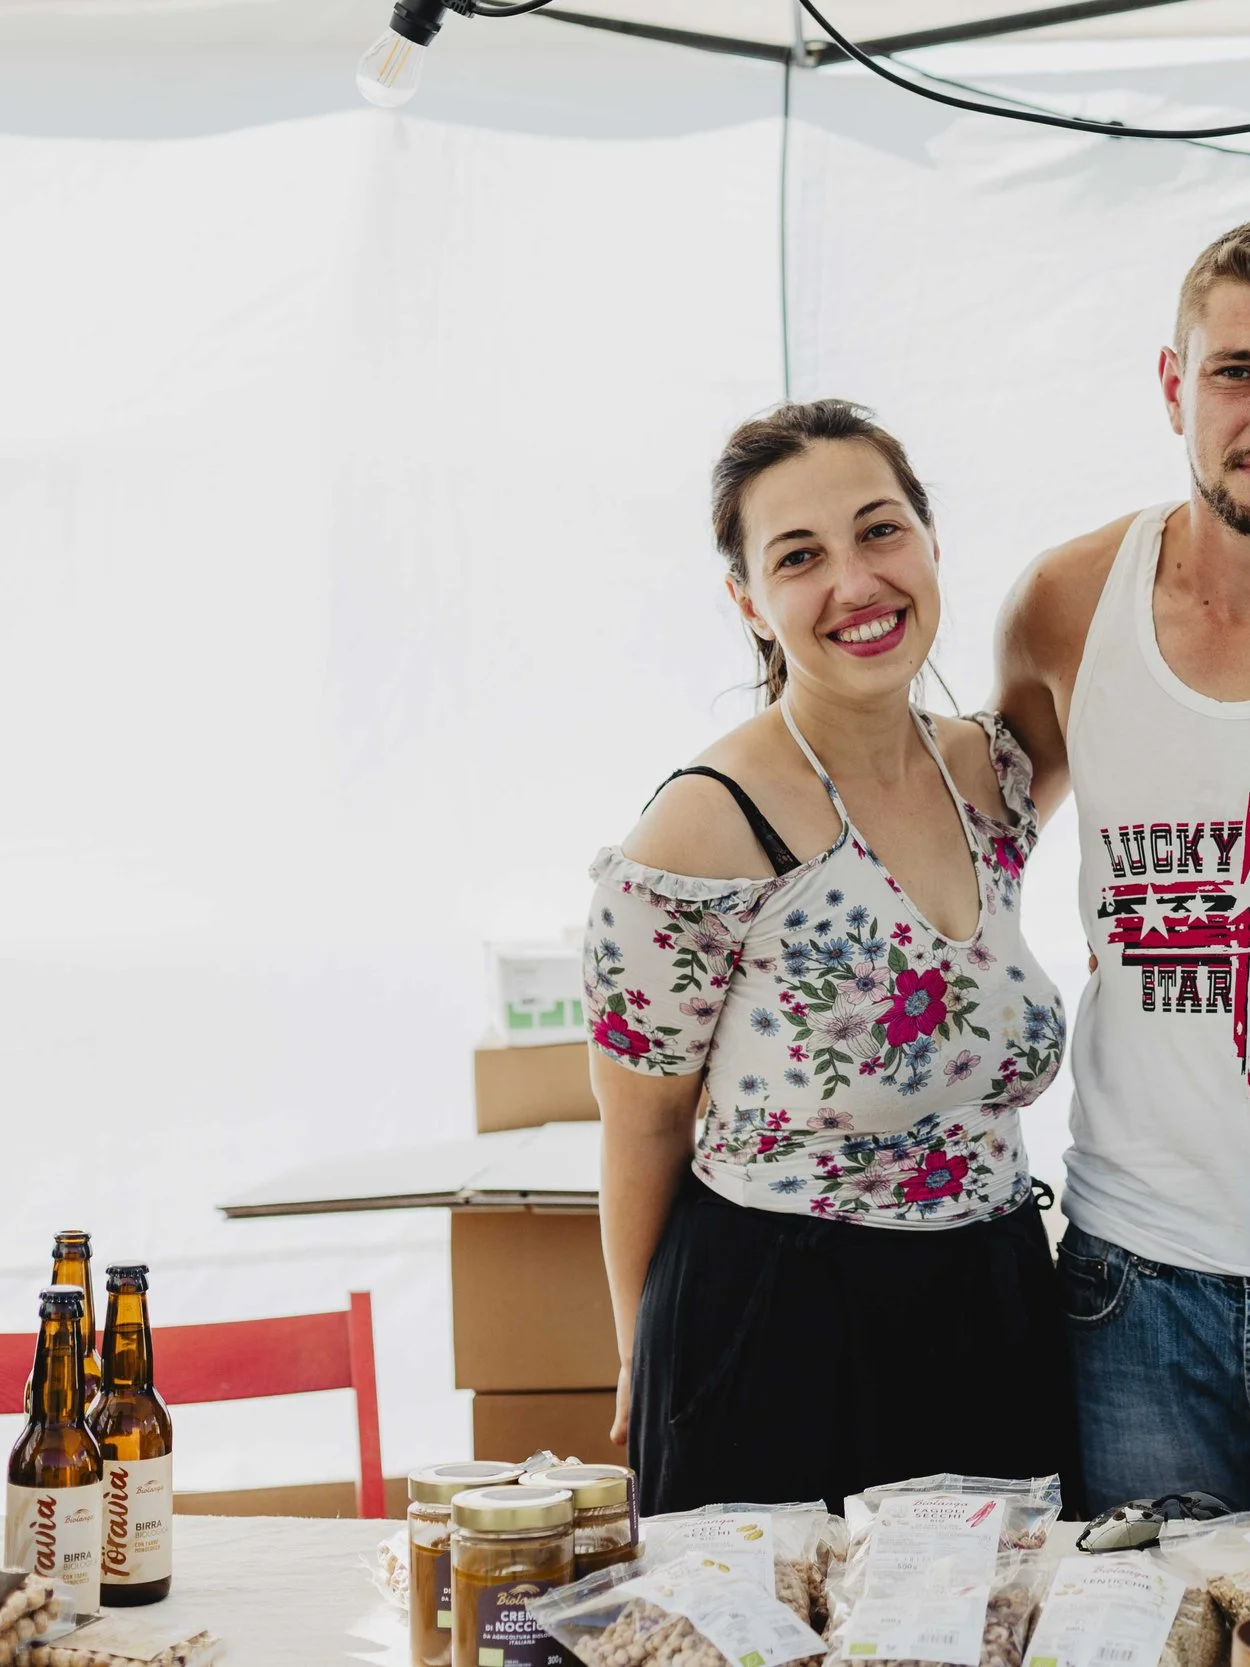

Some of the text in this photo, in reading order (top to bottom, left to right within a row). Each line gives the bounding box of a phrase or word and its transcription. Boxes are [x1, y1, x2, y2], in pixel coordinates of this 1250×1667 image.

[1100, 820, 1243, 878] LUCKY
[1141, 963, 1233, 1013] STAR
[136, 1484, 164, 1495] Biolanga
[135, 1520, 162, 1532] BIRRA
[63, 1552, 92, 1563] BIRRA
[501, 1610, 539, 1622] CREM
[485, 1624, 493, 1632] DI
